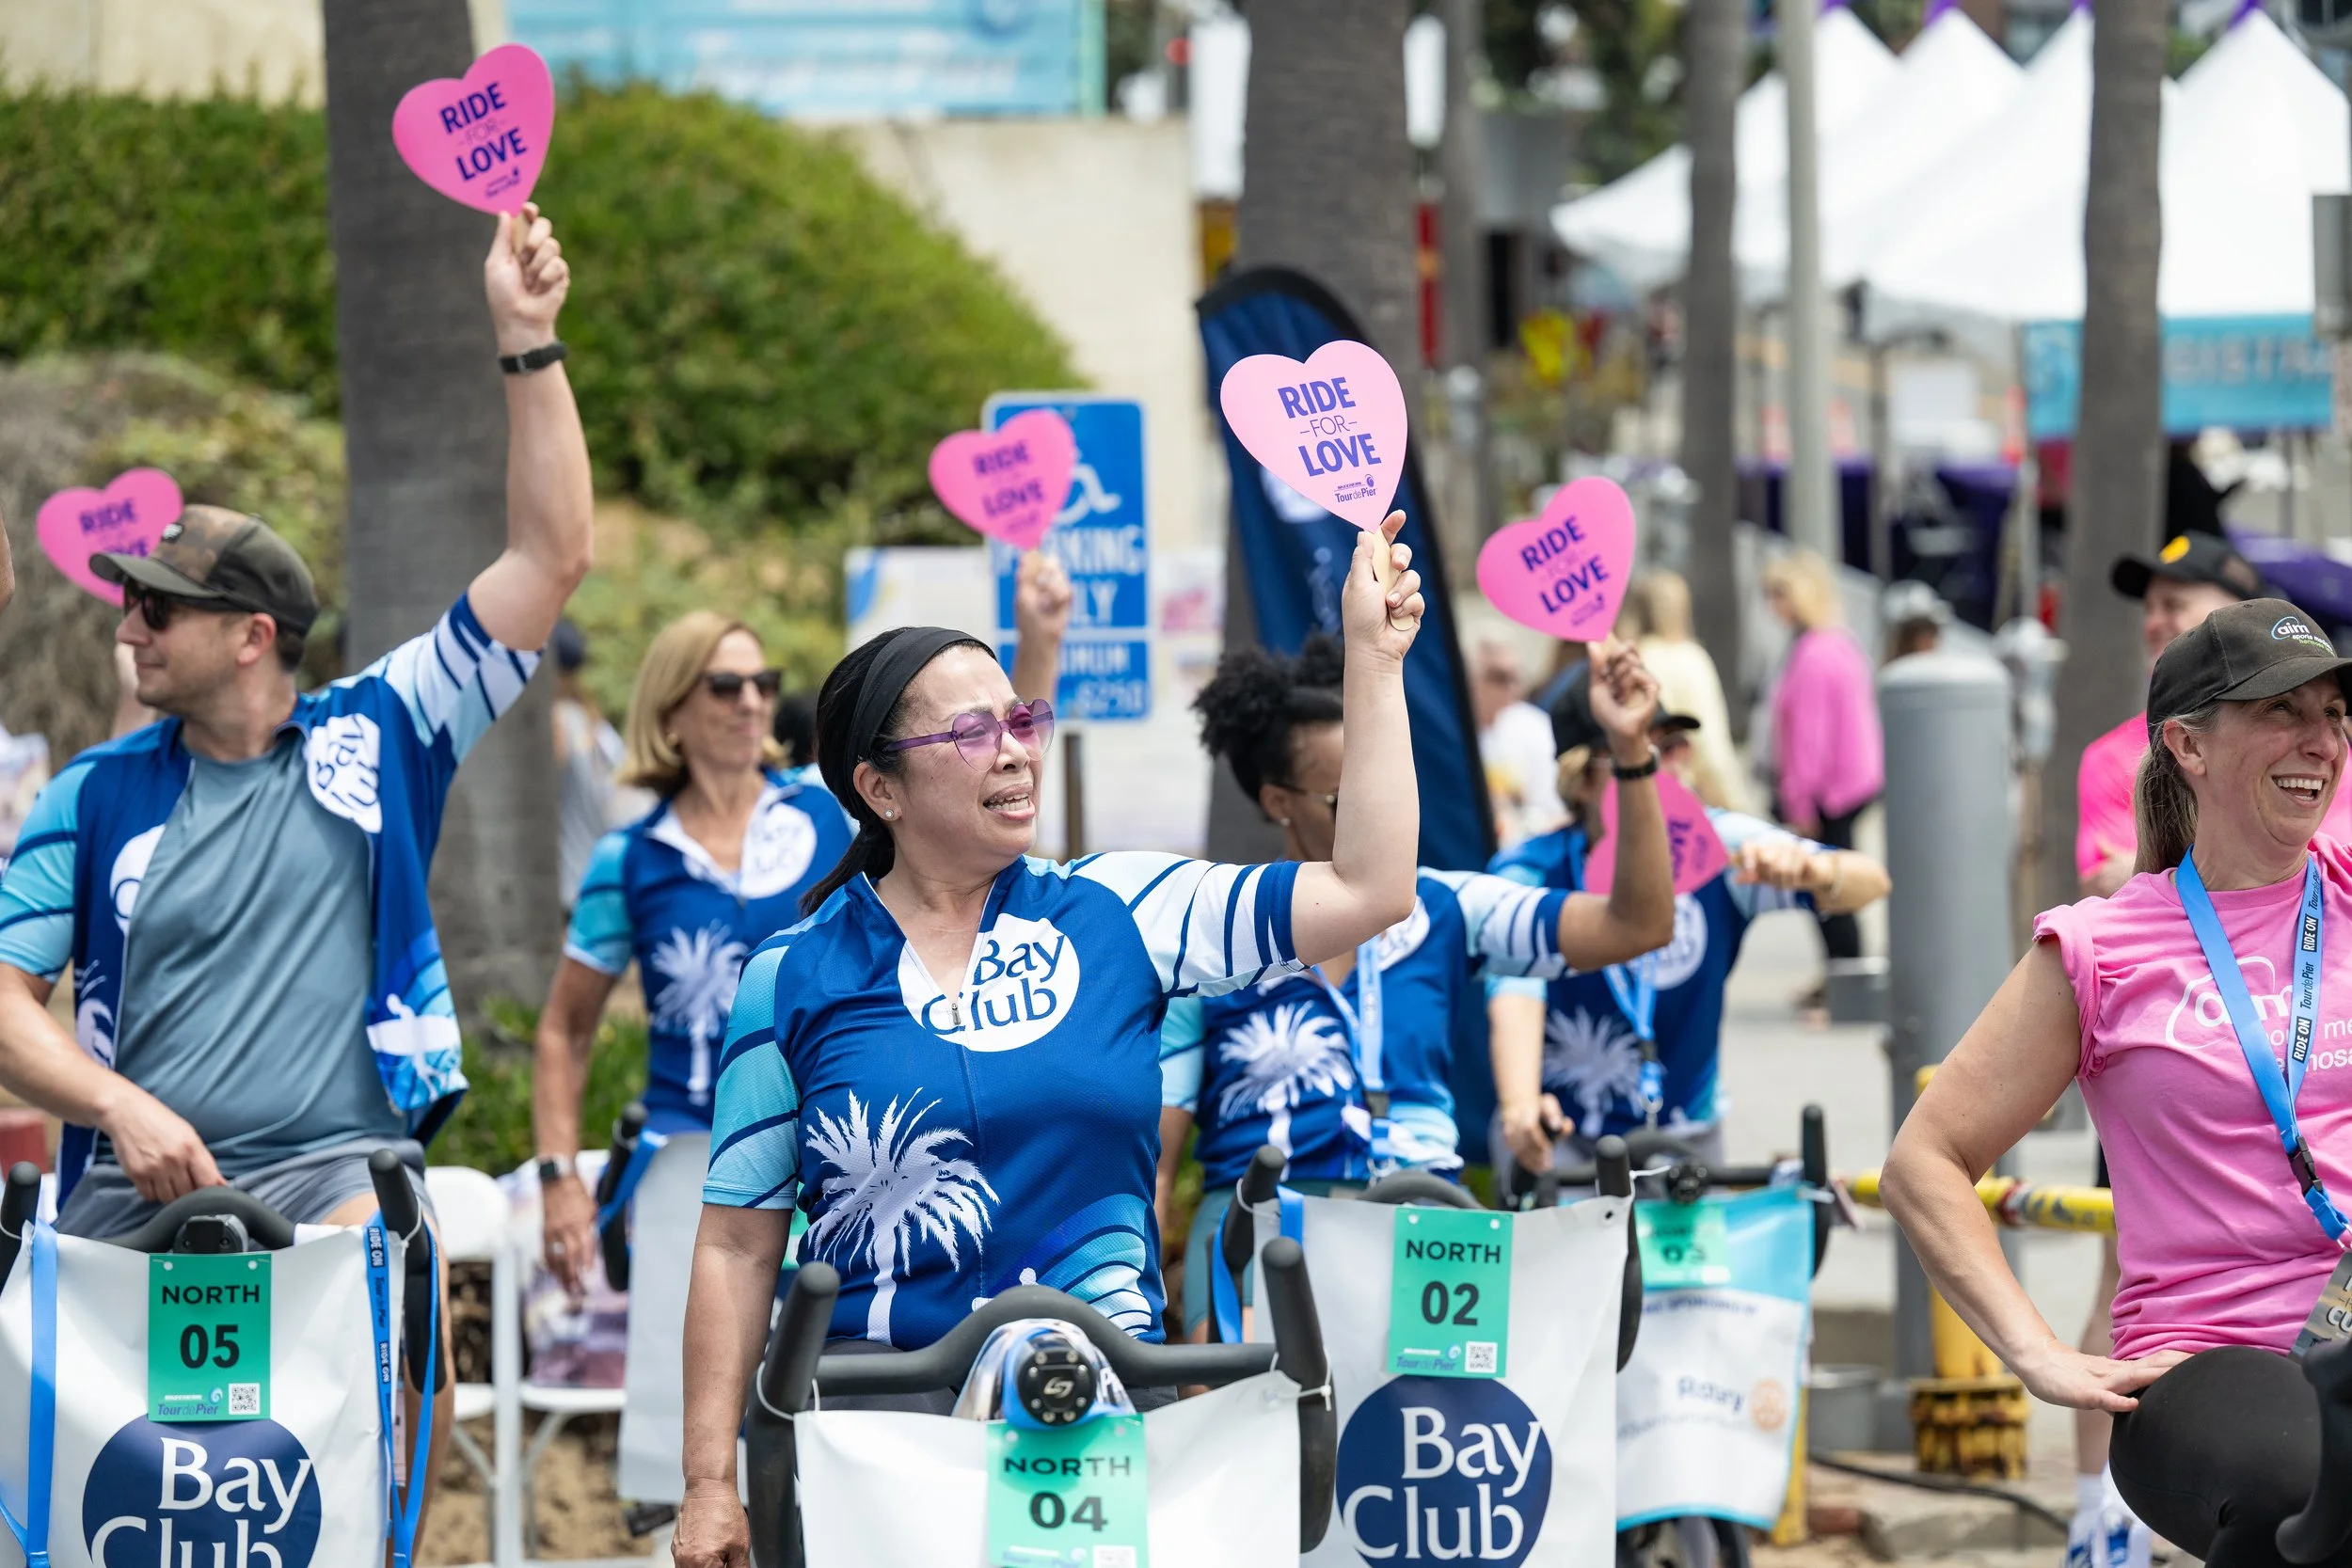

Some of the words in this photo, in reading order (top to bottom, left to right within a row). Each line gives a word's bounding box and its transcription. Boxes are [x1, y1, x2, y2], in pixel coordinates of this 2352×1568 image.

[440, 82, 506, 135] RIDE
[456, 128, 527, 181] LOVE
[1278, 377, 1356, 419] RIDE
[1298, 434, 1381, 476] LOVE
[983, 480, 1044, 515] LOVE
[1520, 515, 1584, 571] RIDE
[1540, 555, 1609, 613] LOVE
[2278, 622, 2310, 635] aim
[2304, 931, 2315, 951] RIDE
[2305, 916, 2317, 930] ON
[973, 934, 1065, 985] Bay
[921, 977, 1057, 1035] Club
[2298, 1018, 2310, 1036] ON
[2294, 1036, 2308, 1061] RIDE
[369, 1227, 383, 1250] RIDE
[372, 1251, 384, 1267] ON
[1406, 1239, 1501, 1263] NORTH
[162, 1285, 260, 1305] NORTH
[1422, 1280, 1479, 1326] 02
[181, 1324, 239, 1369] 05
[380, 1342, 389, 1365] RIDE
[382, 1367, 390, 1382] ON
[1004, 1456, 1130, 1477] NORTH
[1401, 1406, 1541, 1497] Bay
[158, 1437, 312, 1534] Bay
[1030, 1491, 1108, 1532] 04
[1343, 1483, 1524, 1560] Club
[91, 1515, 283, 1568] Club
